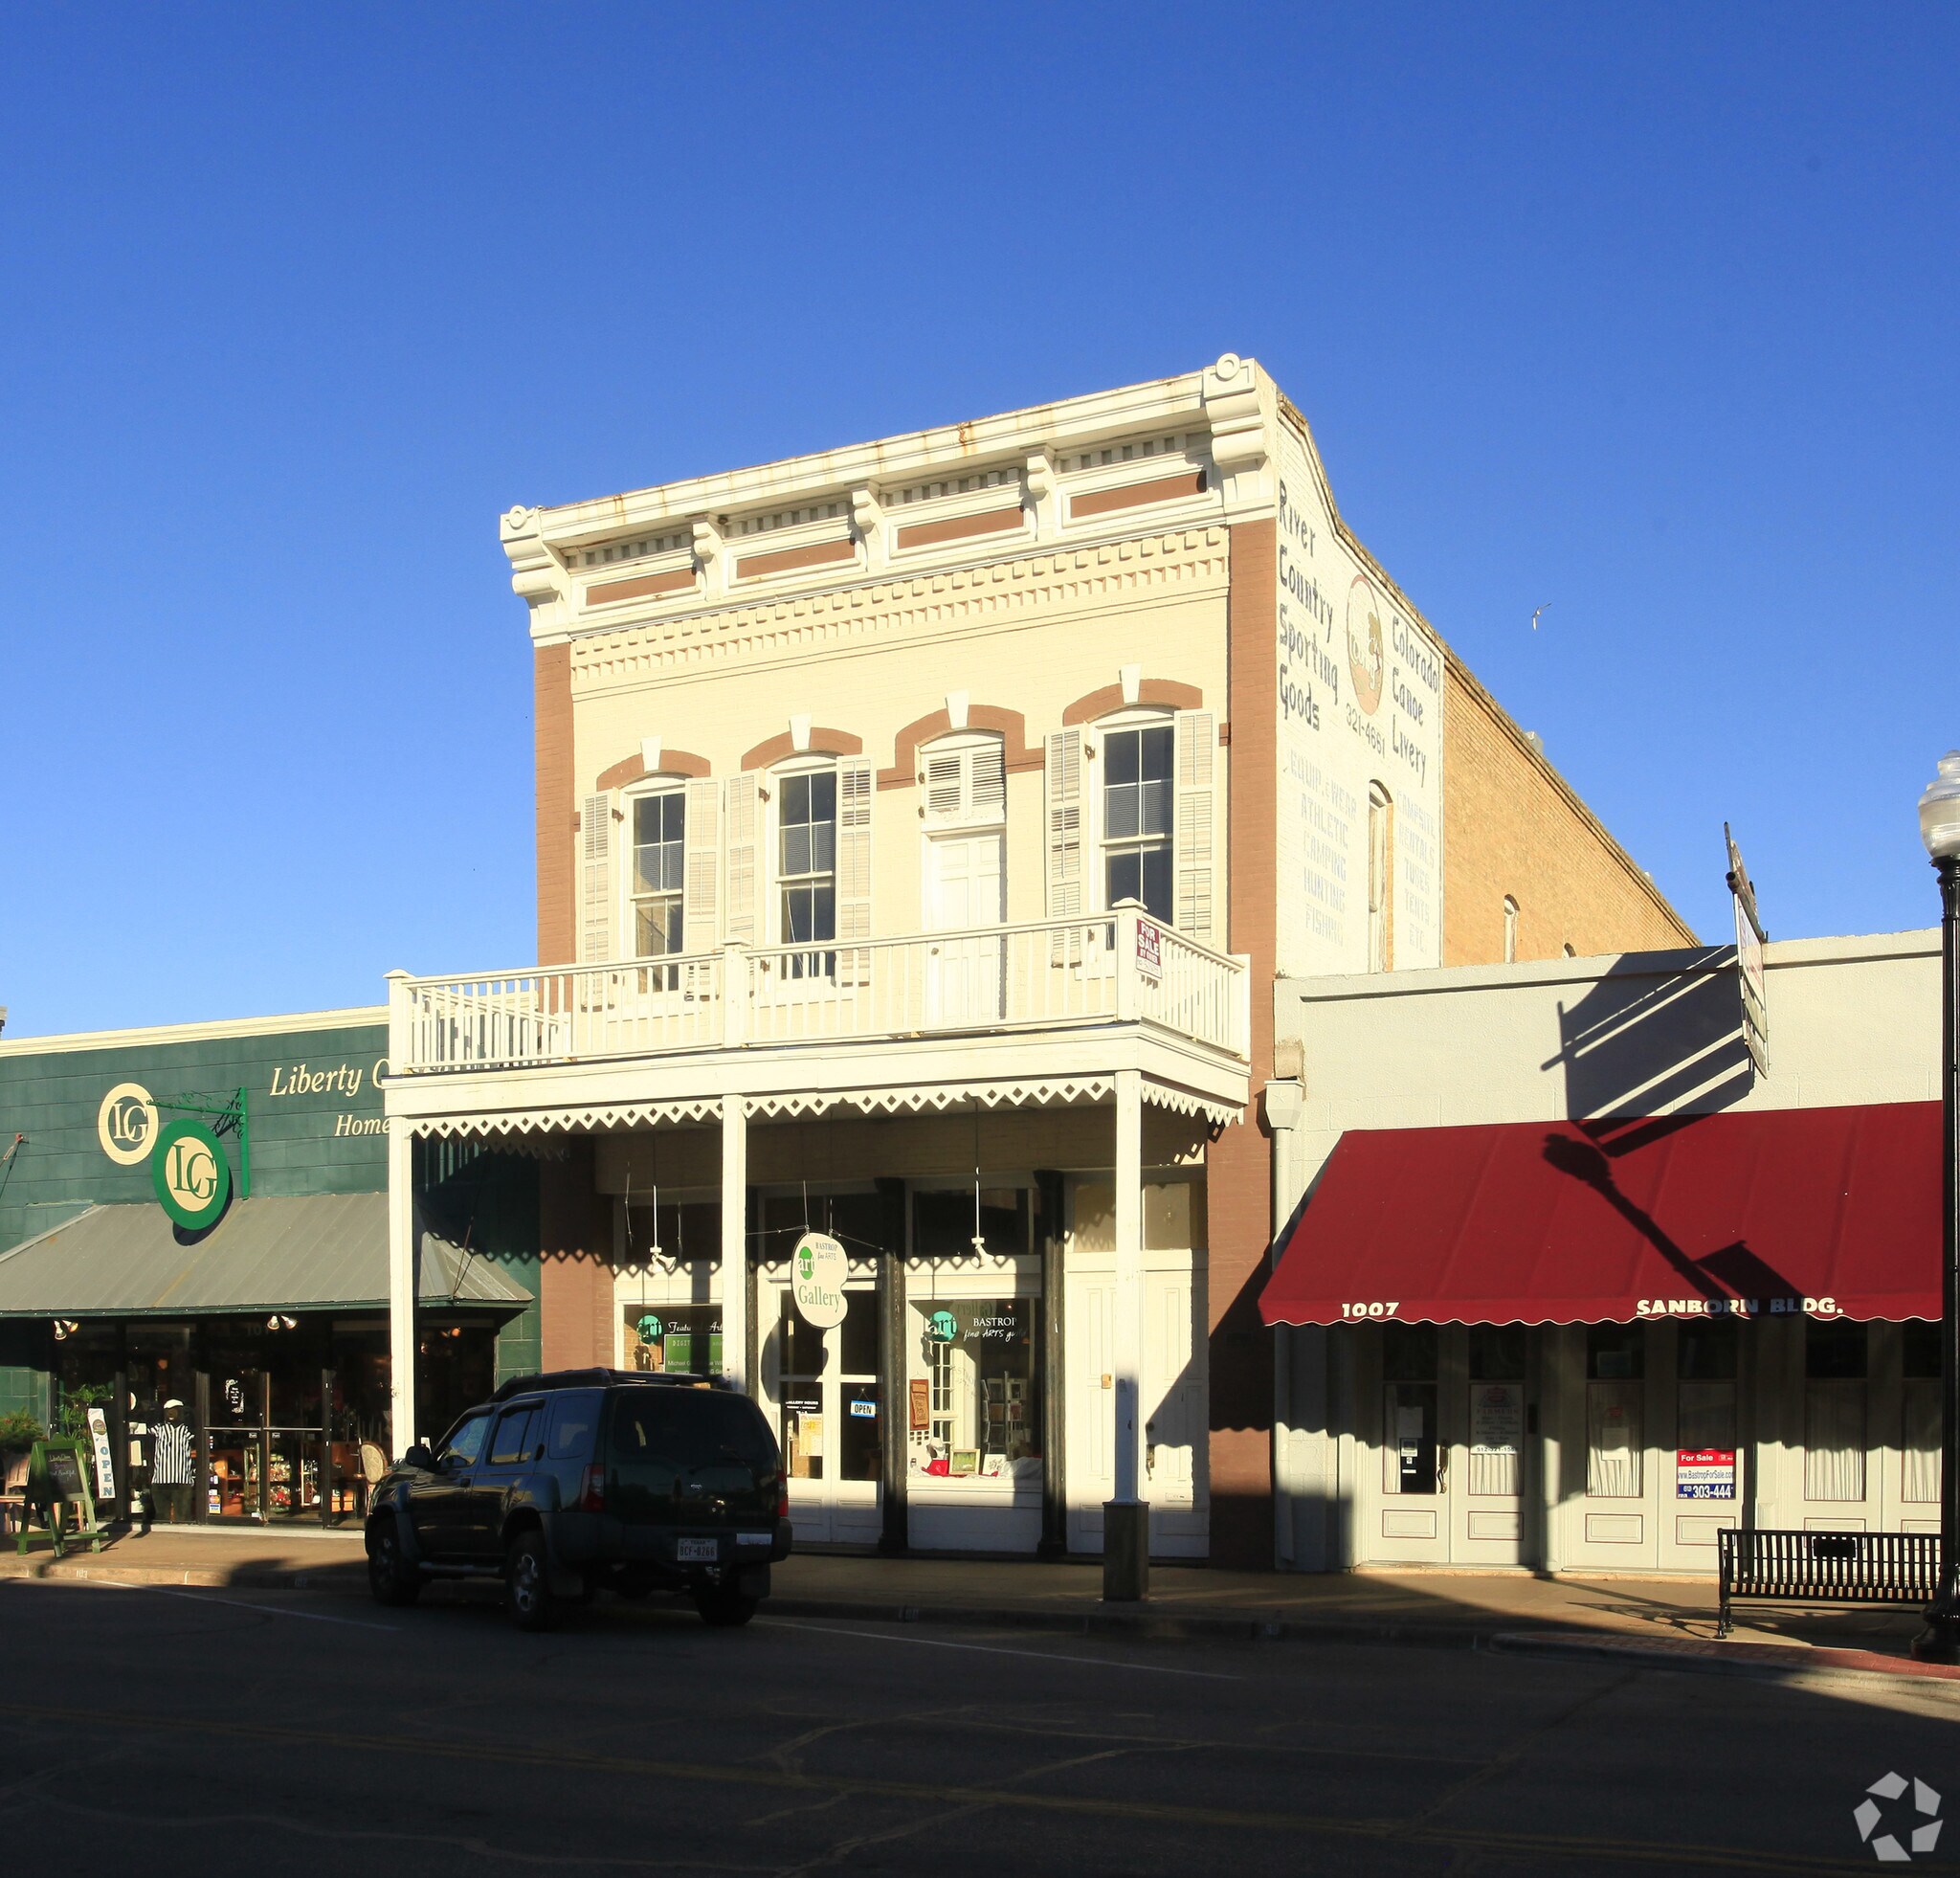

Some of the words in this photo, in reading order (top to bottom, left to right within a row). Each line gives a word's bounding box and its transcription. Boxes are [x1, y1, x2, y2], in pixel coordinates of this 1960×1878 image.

[1279, 479, 1316, 558] River
[1279, 544, 1333, 644] Country
[1279, 603, 1338, 705] Sporting
[1392, 615, 1439, 694] Colorado
[1279, 662, 1320, 731] Goods
[1392, 666, 1423, 727] Canoe
[1346, 703, 1386, 759] 321-4661
[1392, 713, 1426, 789] Livery
[1301, 792, 1349, 851] ATHLETIC
[1303, 830, 1347, 883] CAMPING
[1303, 865, 1346, 913] HUNTING
[1137, 933, 1159, 957] SALE
[1140, 922, 1156, 941] FOR
[1305, 903, 1345, 949] FISHING
[269, 1062, 364, 1098] Liberty
[113, 1103, 148, 1143] LG
[171, 1144, 218, 1200] LG
[815, 1241, 838, 1251] BASTROP
[798, 1285, 841, 1313] Gallery
[1342, 1301, 1400, 1318] 1007
[1636, 1298, 1759, 1316] SANBORN
[1770, 1297, 1844, 1315] BLDG.
[963, 1330, 980, 1342] fine
[982, 1329, 1005, 1338] ARTS
[854, 1403, 873, 1415] OPEN
[100, 1446, 113, 1496] OPEN
[1692, 1485, 1734, 1499] 303-444
